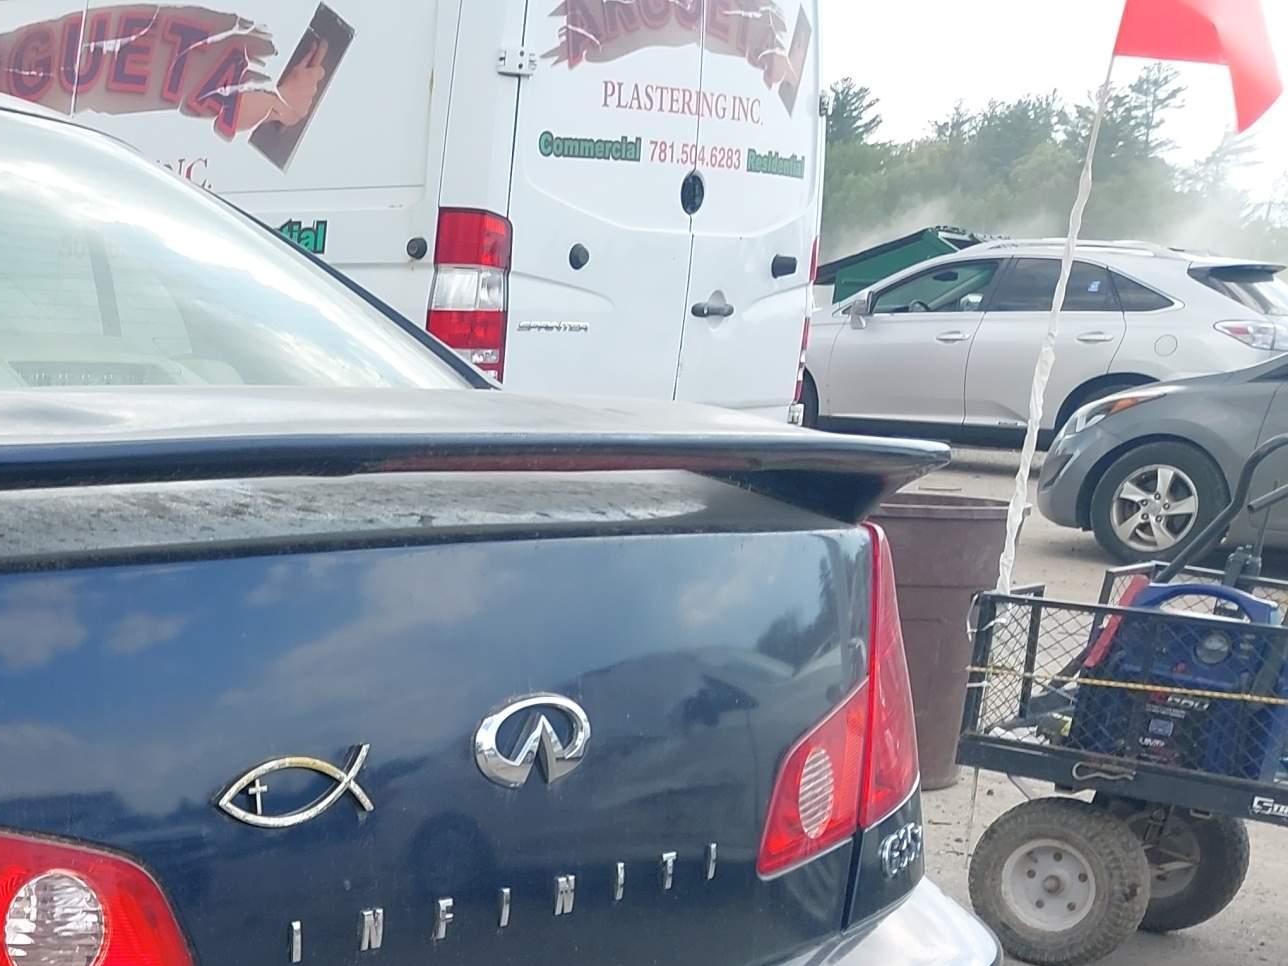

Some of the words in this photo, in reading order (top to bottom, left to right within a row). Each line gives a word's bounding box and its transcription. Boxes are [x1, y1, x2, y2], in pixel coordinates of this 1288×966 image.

[602, 80, 728, 120] PLASTERING
[731, 96, 763, 125] INC.
[539, 130, 641, 162] Commercial
[649, 140, 741, 170] 781.504.6283
[288, 843, 717, 964] INFINITI
